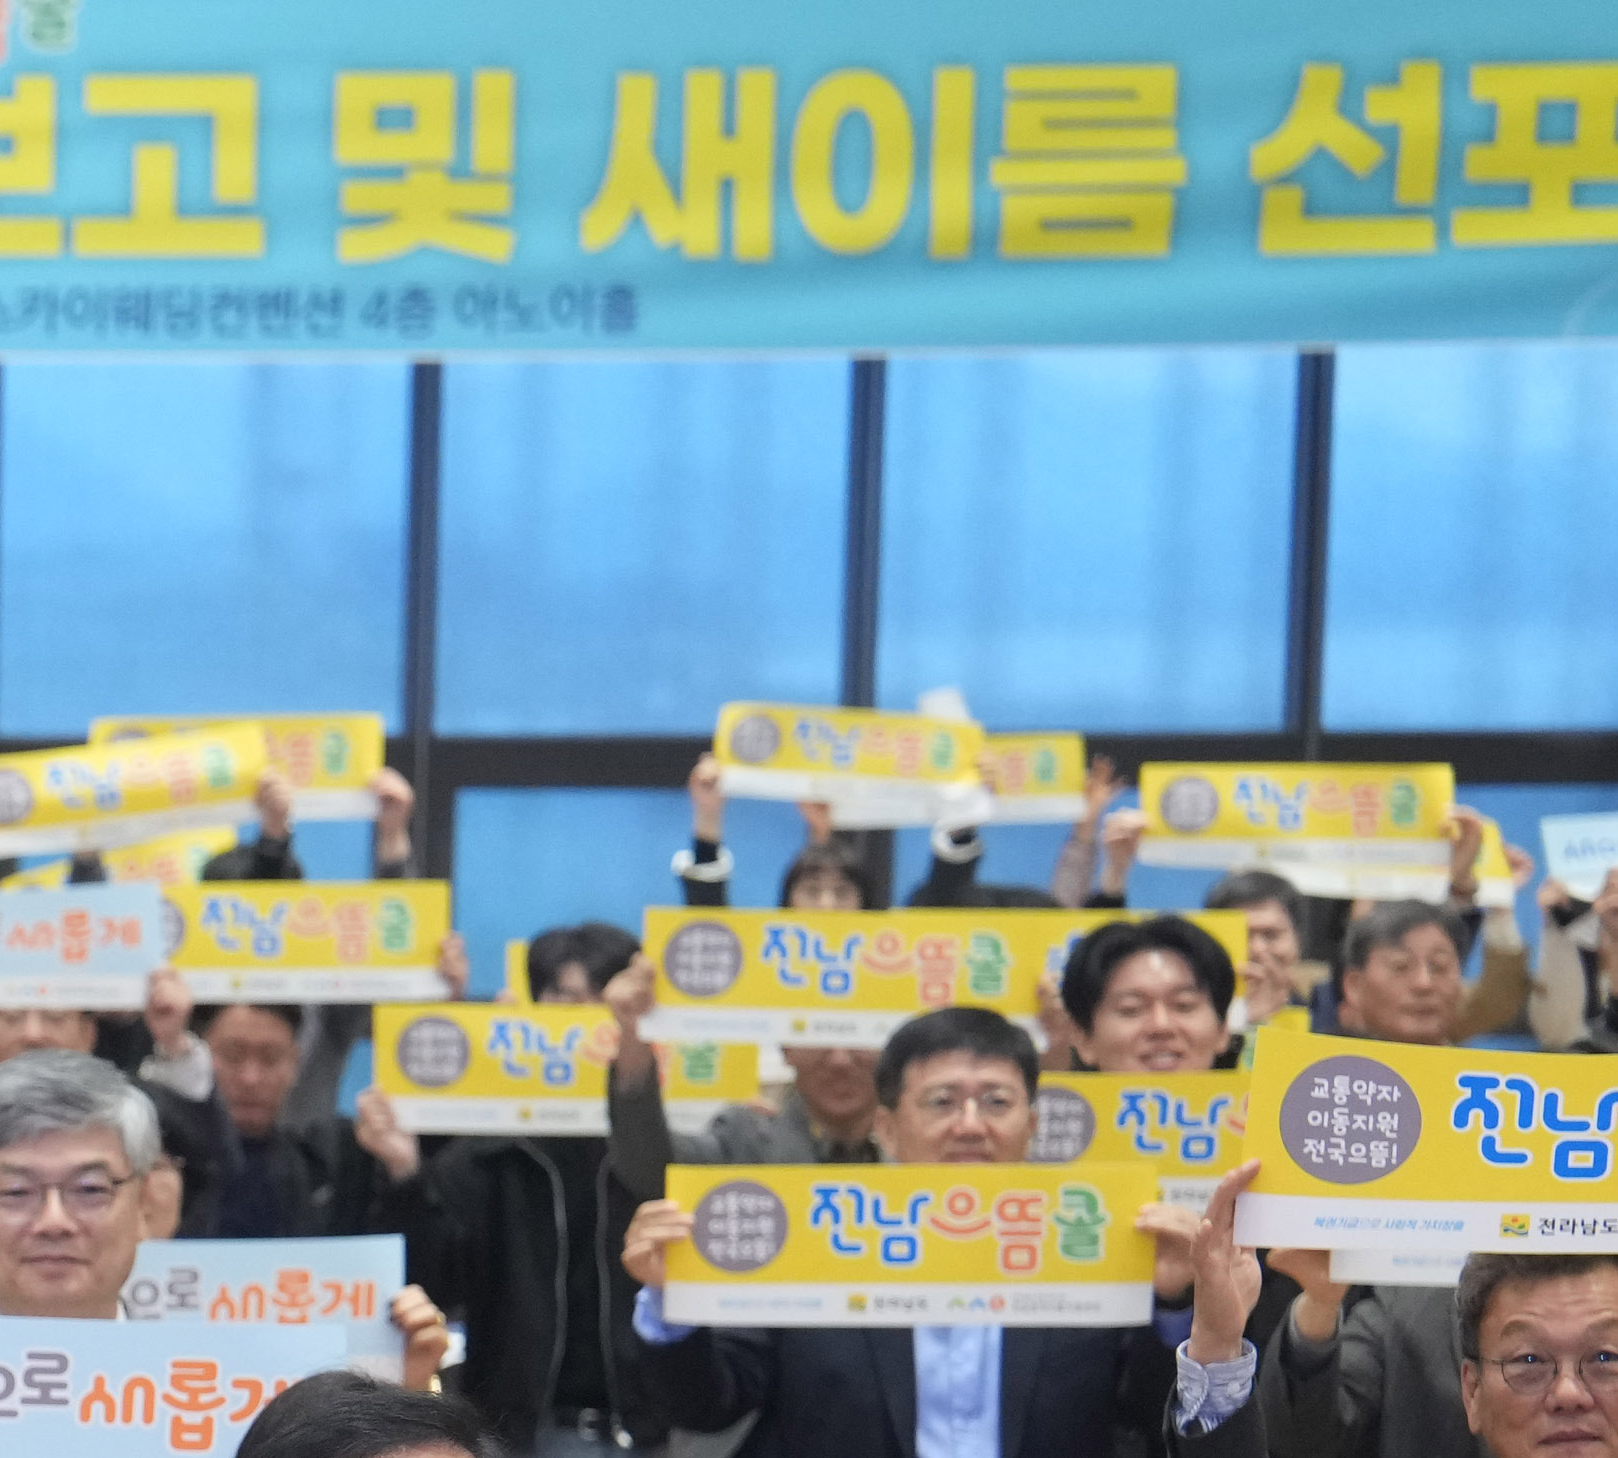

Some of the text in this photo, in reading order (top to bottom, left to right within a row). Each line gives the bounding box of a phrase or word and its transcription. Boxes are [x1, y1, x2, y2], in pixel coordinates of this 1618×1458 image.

[334, 69, 516, 264] 및
[579, 62, 1188, 261] 새이름
[7, 907, 143, 964] 새롭게
[762, 923, 1012, 1007] 전남으뜸콜
[1310, 1075, 1402, 1105] 교통약자
[1307, 1108, 1400, 1139] 이동지원
[1303, 1137, 1399, 1168] 전국으뜸!
[811, 1185, 1108, 1273] 전남으뜸콜
[1537, 1216, 1618, 1237] 전라남도
